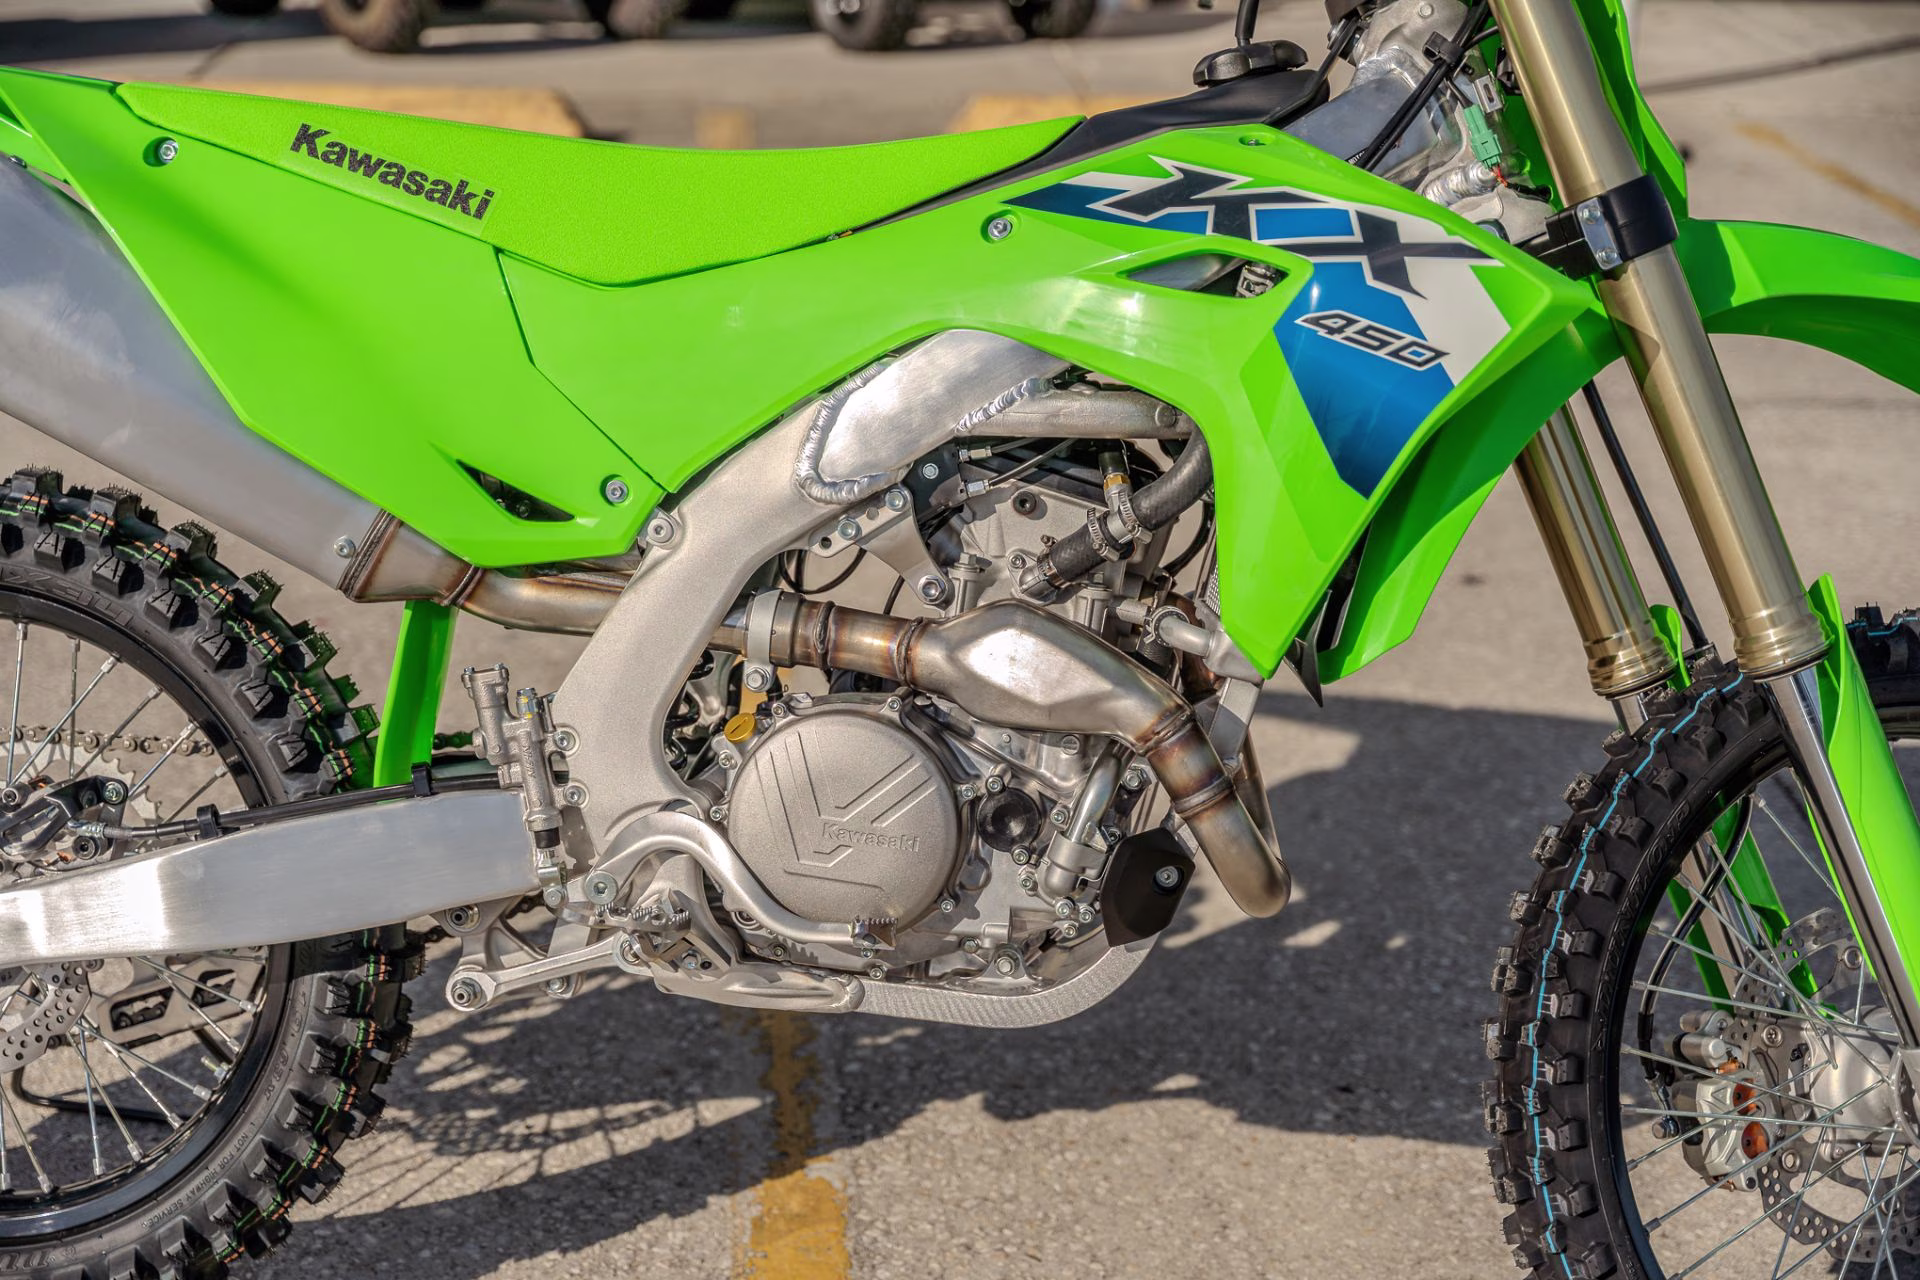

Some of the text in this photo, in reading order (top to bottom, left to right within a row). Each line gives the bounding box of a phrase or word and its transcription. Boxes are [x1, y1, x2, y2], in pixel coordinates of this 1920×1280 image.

[289, 122, 496, 221] Kawasaki
[1296, 311, 1450, 371] 450
[822, 822, 920, 852] Kawasaki
[235, 1132, 249, 1153] NOT
[219, 1154, 234, 1170] FOR
[186, 1168, 218, 1201] HIGHWAY
